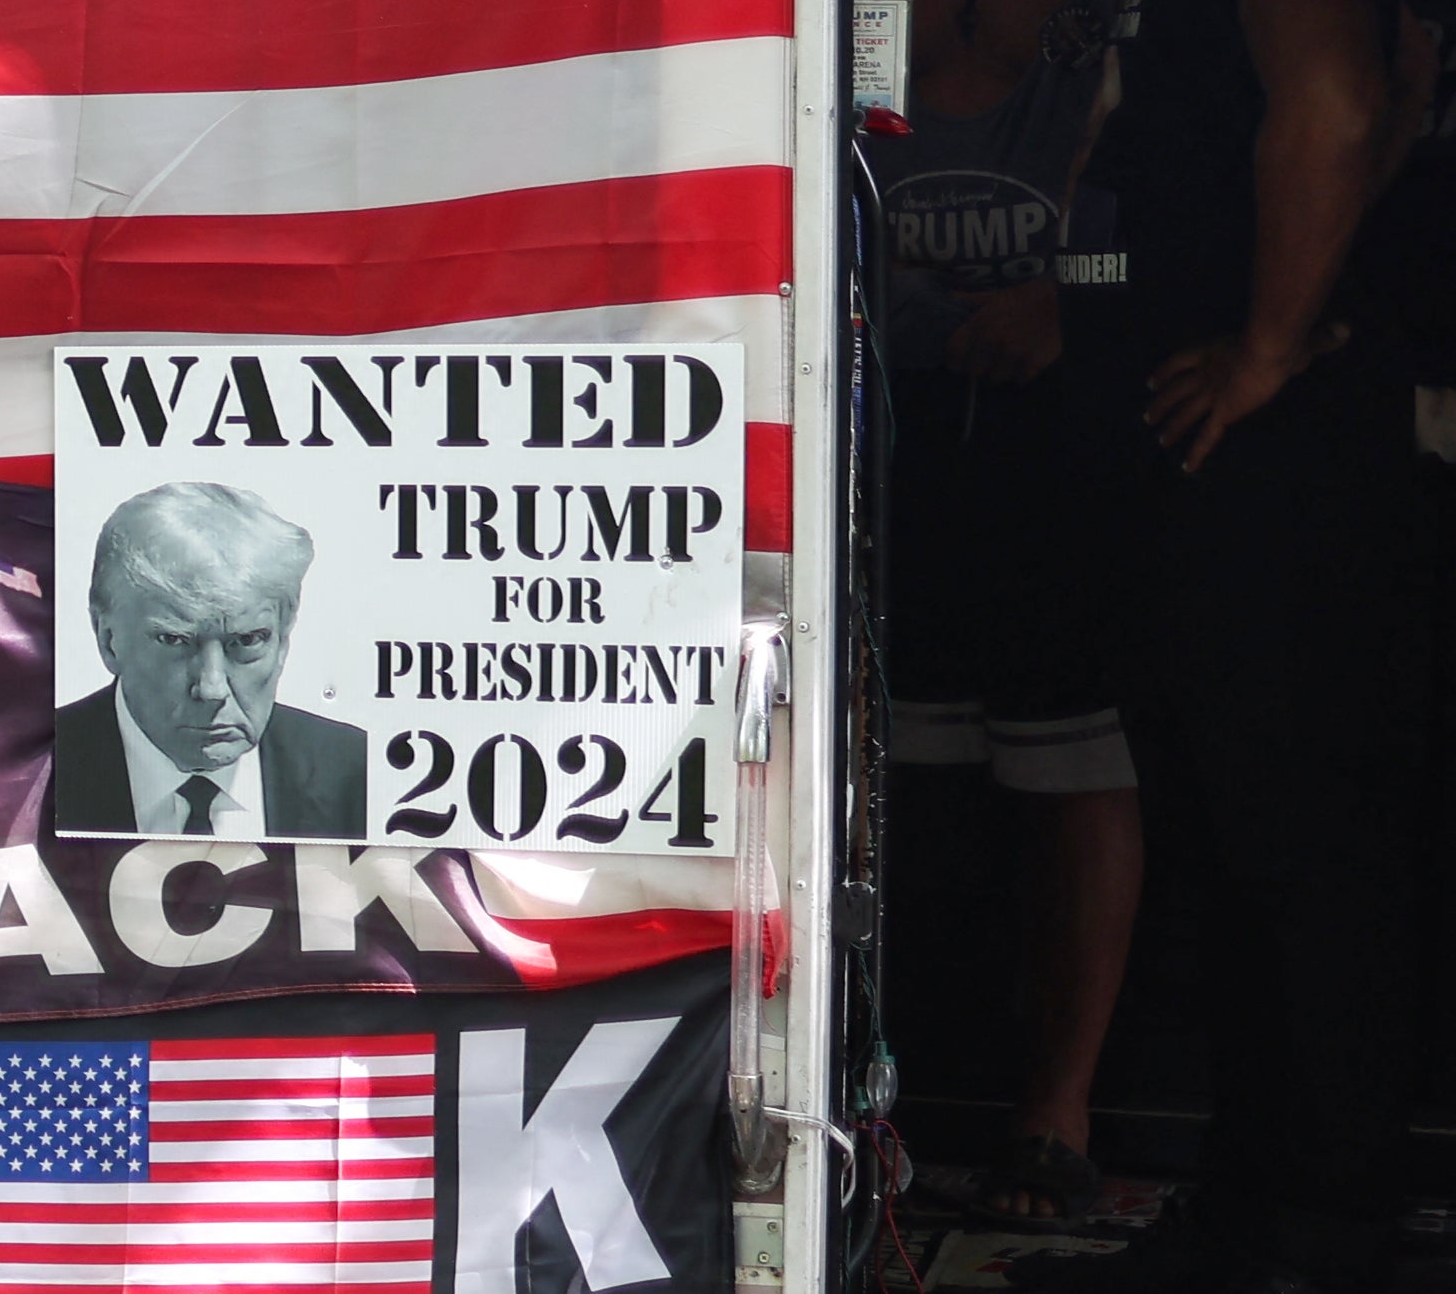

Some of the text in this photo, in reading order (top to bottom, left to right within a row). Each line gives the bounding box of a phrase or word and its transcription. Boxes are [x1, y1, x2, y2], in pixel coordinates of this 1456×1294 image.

[64, 356, 723, 448] WANTED
[379, 484, 723, 562] TRUMP
[492, 577, 604, 623] FOR
[375, 641, 724, 704] PRESIDENT
[386, 730, 718, 846] 2024
